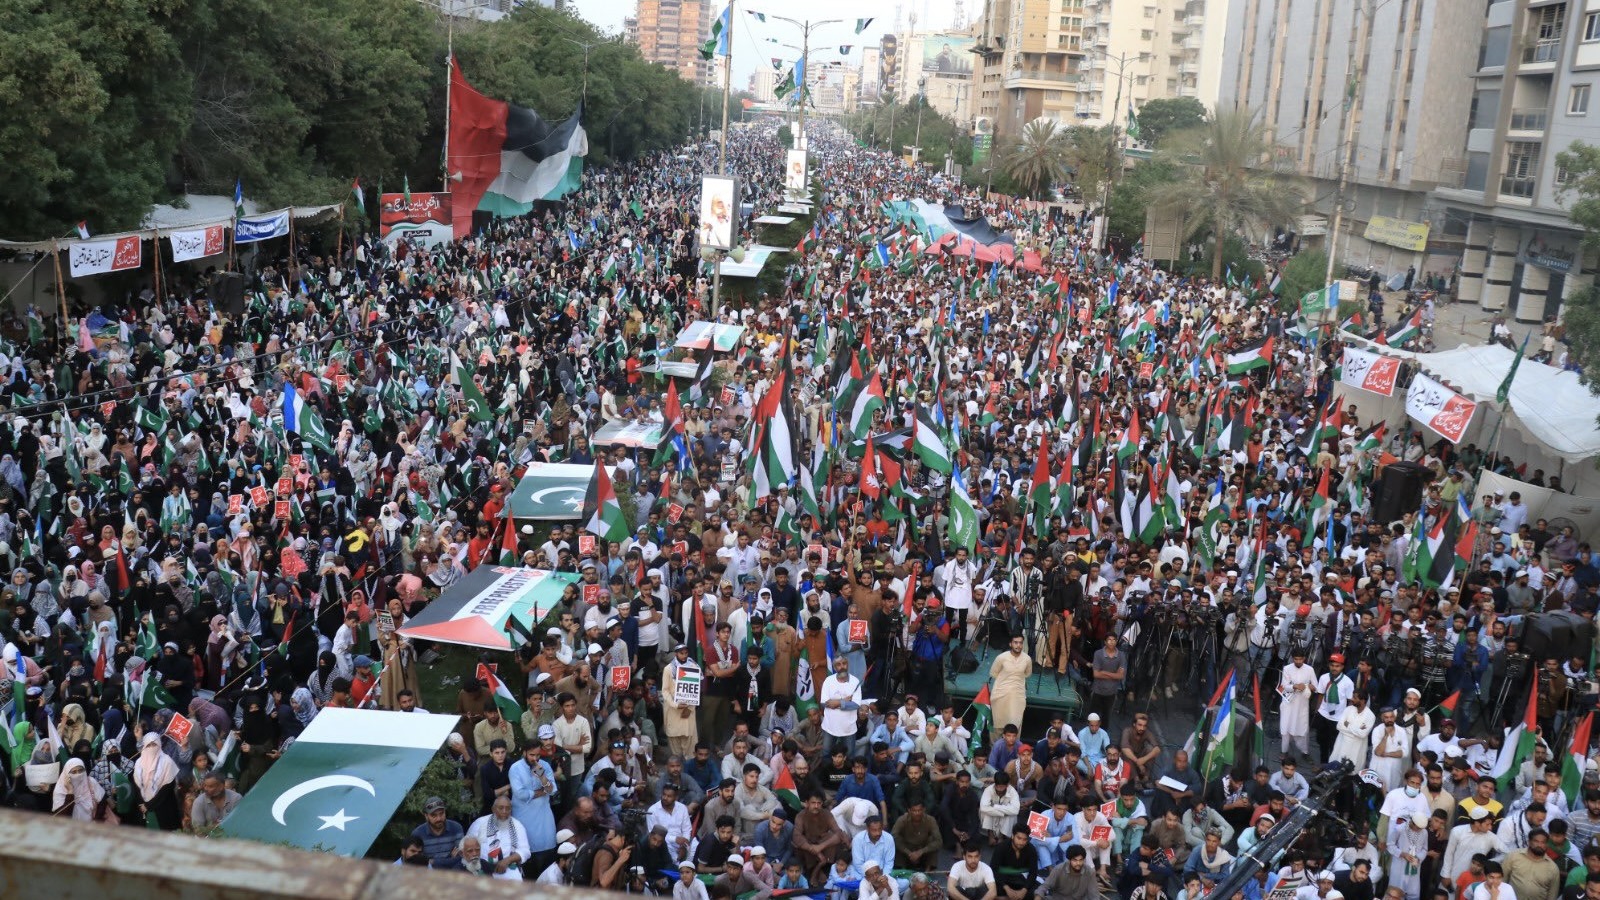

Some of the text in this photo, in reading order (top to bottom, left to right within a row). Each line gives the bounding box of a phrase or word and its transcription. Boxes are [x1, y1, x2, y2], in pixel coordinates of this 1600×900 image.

[471, 597, 504, 616] FREE
[676, 682, 699, 694] FREE
[1269, 889, 1295, 898] FREE
